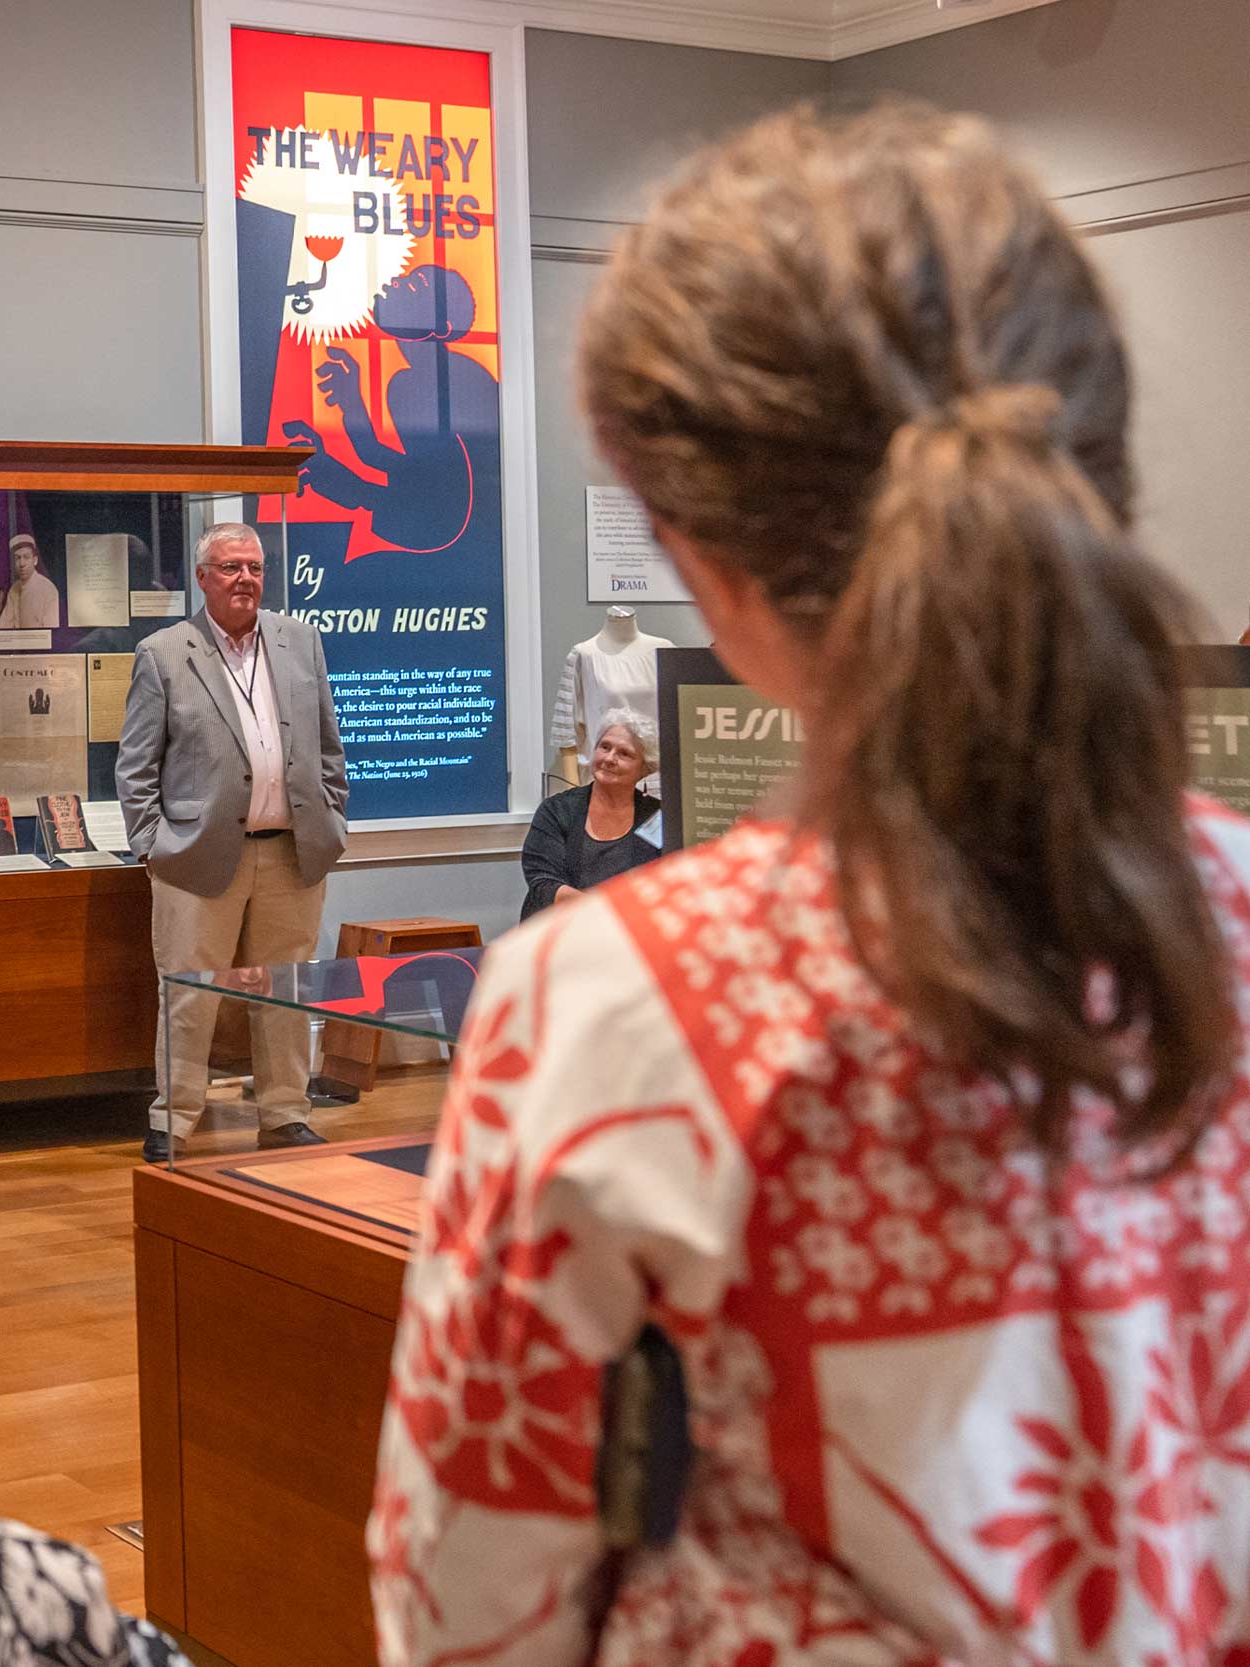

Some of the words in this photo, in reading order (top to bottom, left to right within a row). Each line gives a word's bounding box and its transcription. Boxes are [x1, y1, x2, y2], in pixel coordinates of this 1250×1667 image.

[247, 126, 320, 170] THE
[329, 128, 479, 182] WEARY
[353, 191, 480, 239] BLUES
[293, 554, 326, 600] by
[611, 579, 648, 591] DRAMA
[263, 608, 381, 633] NGSTON
[392, 607, 488, 633] HUGHES
[327, 670, 361, 681] ountain
[362, 669, 400, 683] standing
[400, 669, 410, 680] in
[411, 668, 426, 680] the
[427, 671, 444, 682] way
[445, 667, 457, 678] of
[456, 670, 472, 681] any
[473, 669, 492, 677] true
[397, 686, 418, 698] urge
[418, 683, 447, 694] within
[448, 682, 463, 693] the
[463, 685, 482, 693] race
[342, 701, 358, 712] the
[358, 700, 385, 712] desire
[385, 702, 395, 711] to
[396, 702, 418, 714] pour
[418, 698, 442, 710] racial
[442, 697, 496, 711] individuality
[340, 716, 383, 728] American
[383, 713, 453, 726] standardization,
[453, 712, 470, 723] and
[471, 714, 481, 723] to
[481, 712, 493, 722] be
[356, 734, 366, 743] as
[367, 730, 392, 742] much
[393, 729, 435, 741] American
[436, 732, 446, 740] as
[375, 760, 395, 770] Negro
[395, 758, 407, 767] and
[408, 758, 418, 767] the
[418, 756, 439, 766] Racial
[348, 771, 361, 780] The
[361, 771, 383, 780] Nation
[383, 770, 401, 780] (June
